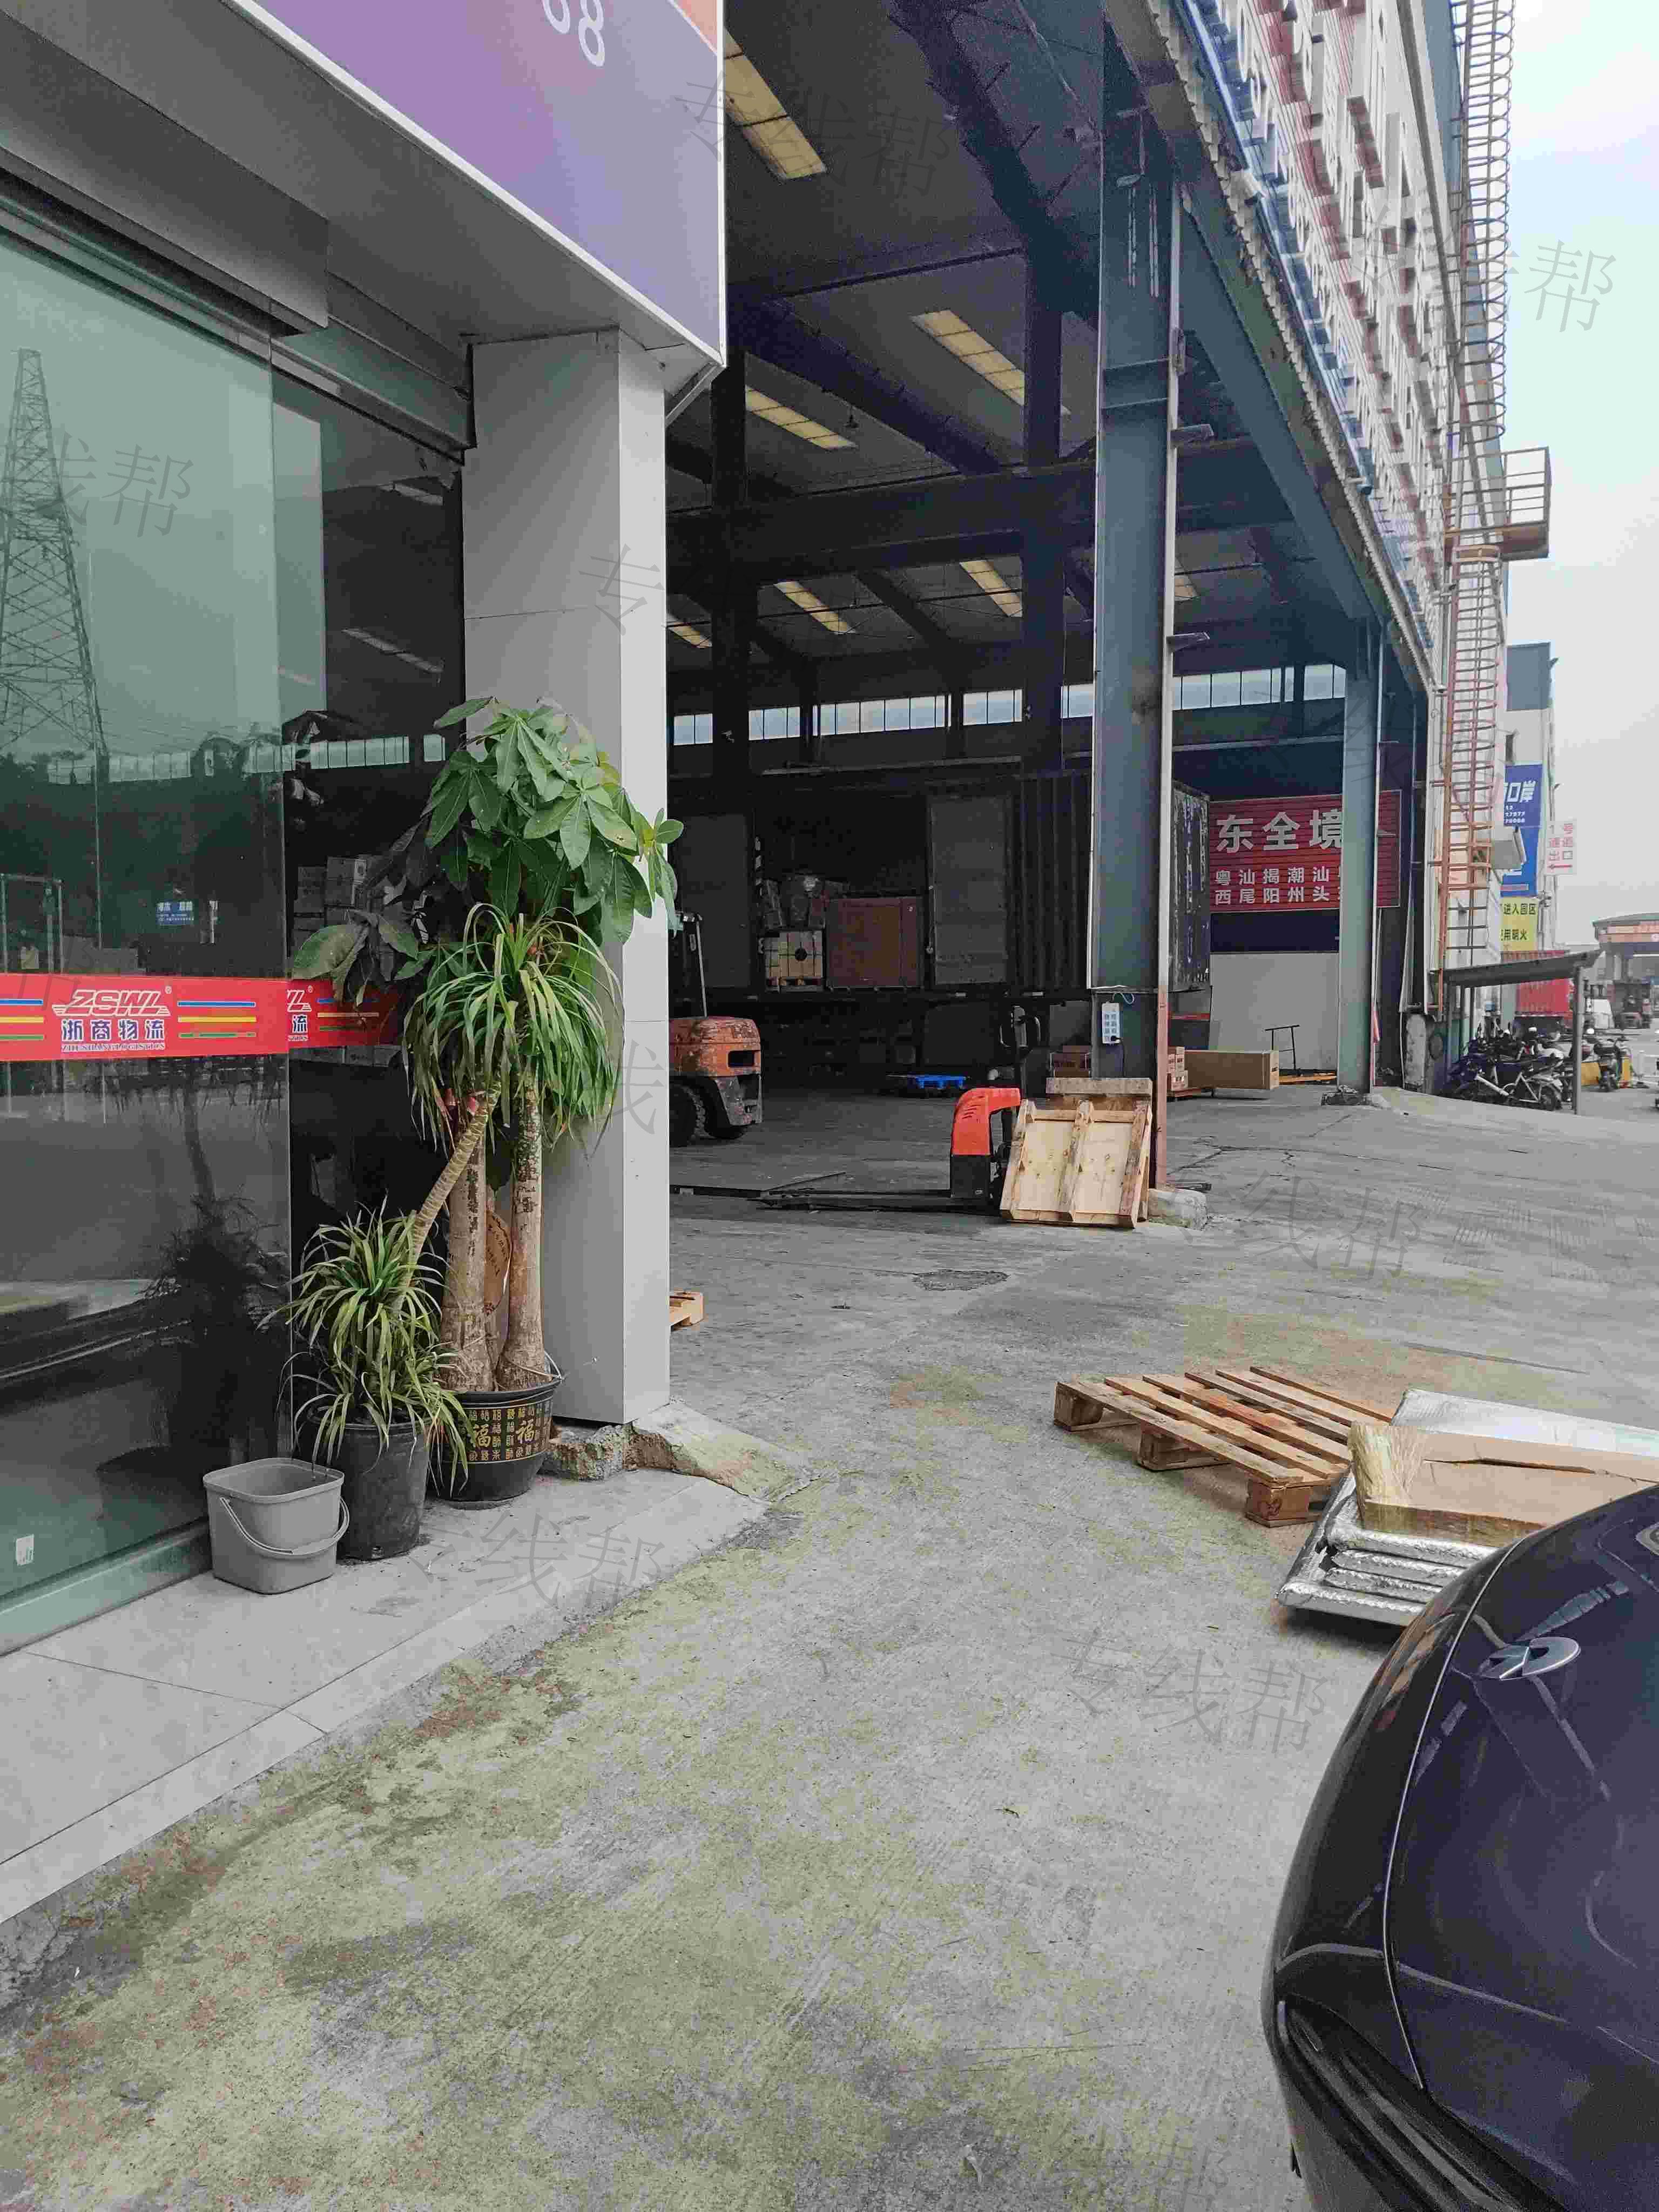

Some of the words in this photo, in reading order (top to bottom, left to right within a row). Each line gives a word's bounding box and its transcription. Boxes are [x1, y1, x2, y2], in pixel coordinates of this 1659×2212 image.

[1503, 781, 1536, 803] 口岸
[1217, 809, 1343, 853] 东全境
[62, 1019, 165, 1047] 浙商物流
